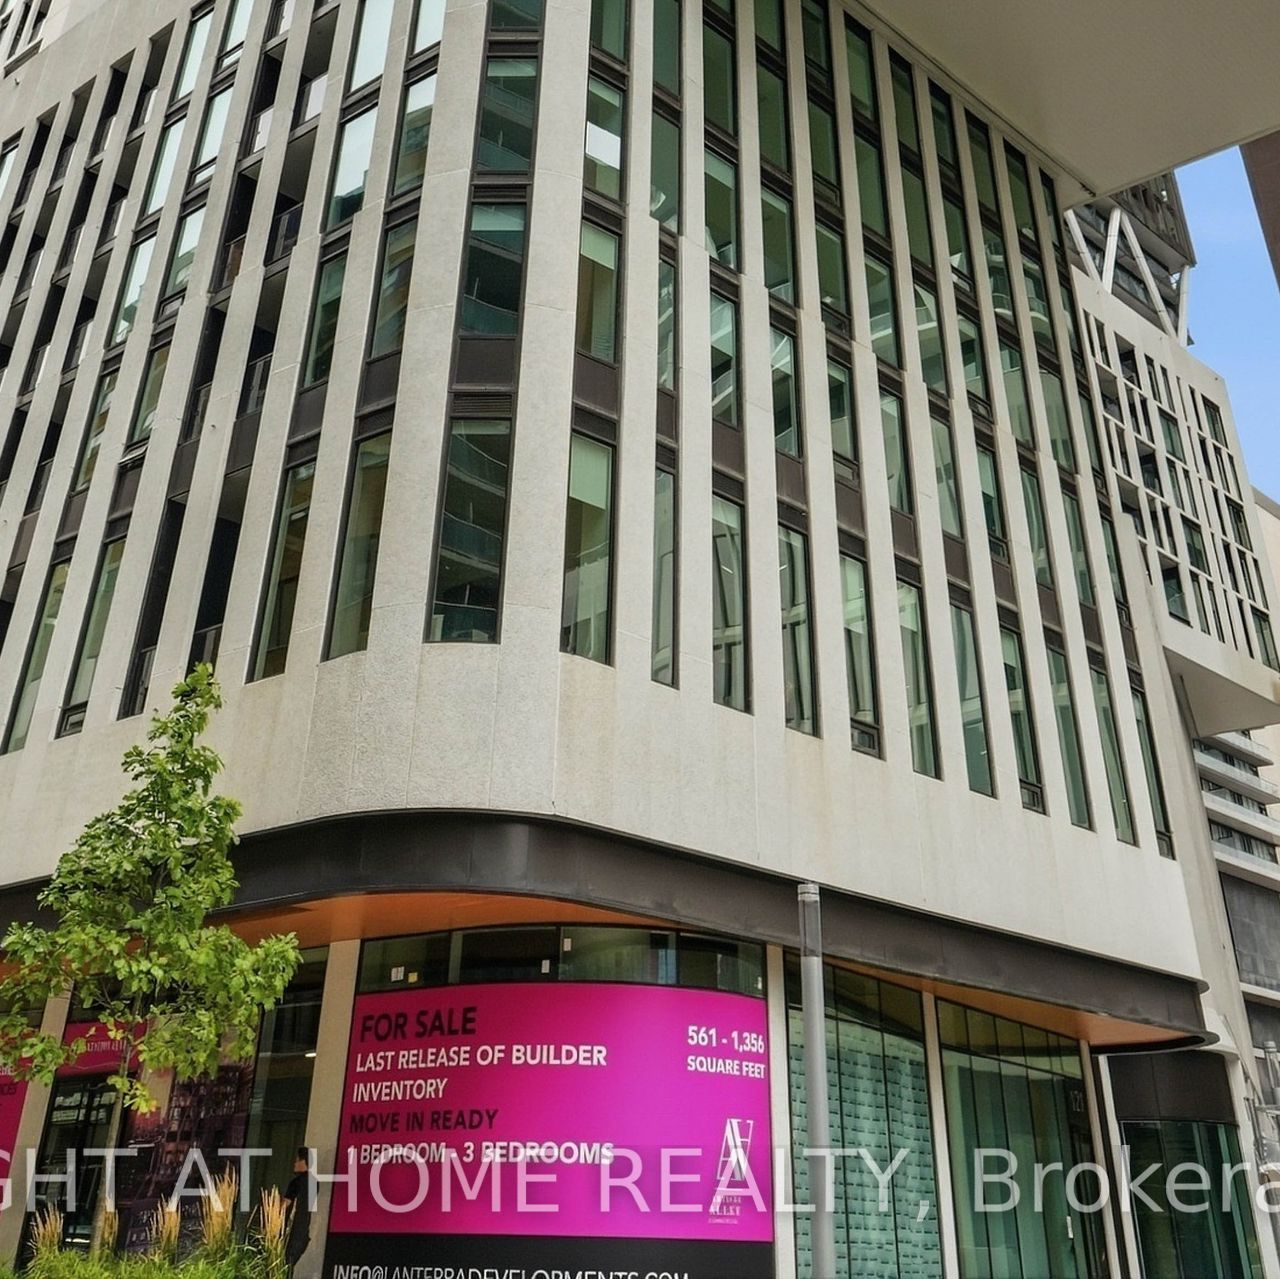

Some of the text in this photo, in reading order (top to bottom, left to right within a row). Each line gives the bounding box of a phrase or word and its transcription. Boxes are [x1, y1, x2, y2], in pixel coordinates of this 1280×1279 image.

[360, 1006, 477, 1042] FOR SALE
[687, 1025, 717, 1047] 561
[731, 1030, 765, 1054] 1,356
[356, 1045, 607, 1072] LAST RELEASE OF BUILDER
[687, 1055, 766, 1079] SQUARE FEET
[352, 1078, 448, 1102] INVENTORY
[349, 1109, 499, 1133] MOVE IN READY
[348, 1145, 355, 1165] 1
[360, 1142, 446, 1165] BEDROOM
[462, 1141, 475, 1163] 3
[481, 1141, 615, 1166] BEDROOMS
